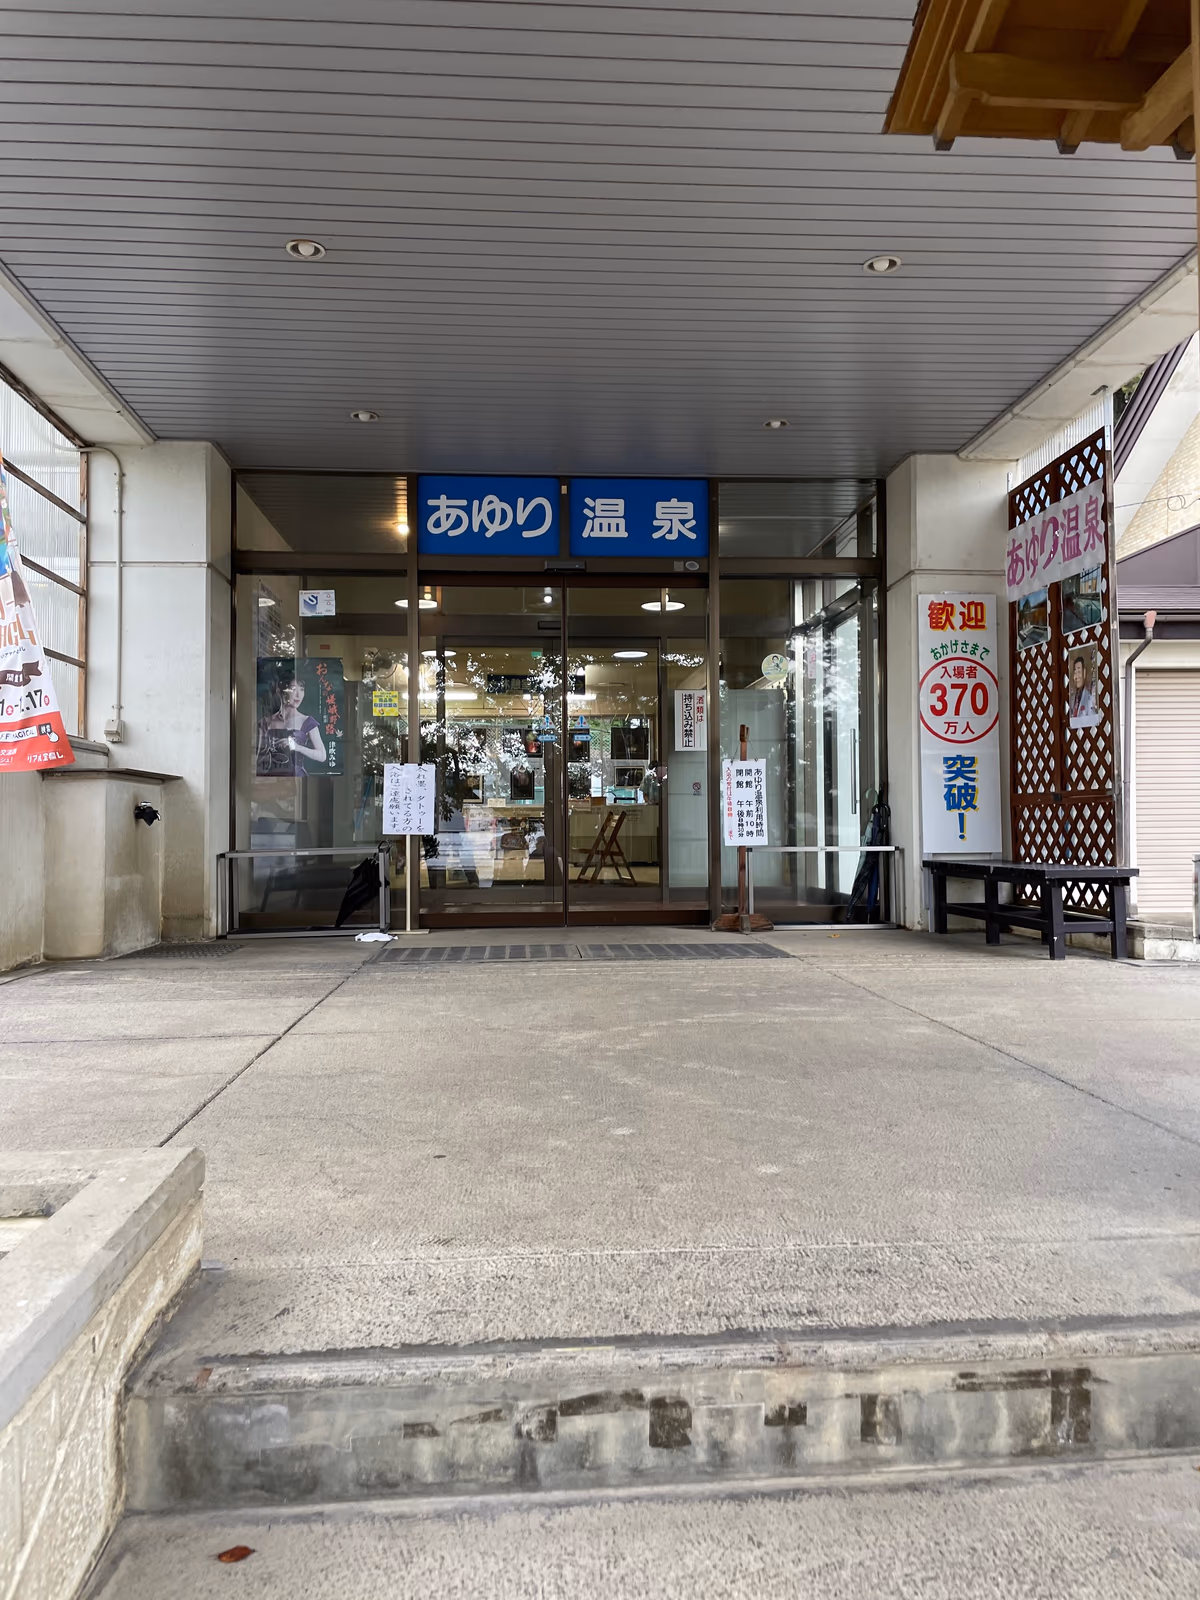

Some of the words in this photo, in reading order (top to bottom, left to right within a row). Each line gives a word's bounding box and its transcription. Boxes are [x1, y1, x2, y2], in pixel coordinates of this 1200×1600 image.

[427, 494, 553, 538] あゆり
[582, 497, 697, 540] 温泉
[1006, 494, 1103, 587] あゆり温泉
[927, 600, 987, 632] 歓迎
[930, 639, 990, 662] おかげさまで
[940, 665, 978, 679] 入場者
[929, 681, 989, 717] 370
[683, 693, 694, 748] 持ち込み禁止
[944, 721, 976, 735] 万人
[754, 768, 765, 837] あゆり温泉利用時間
[942, 754, 979, 841] 突破!
